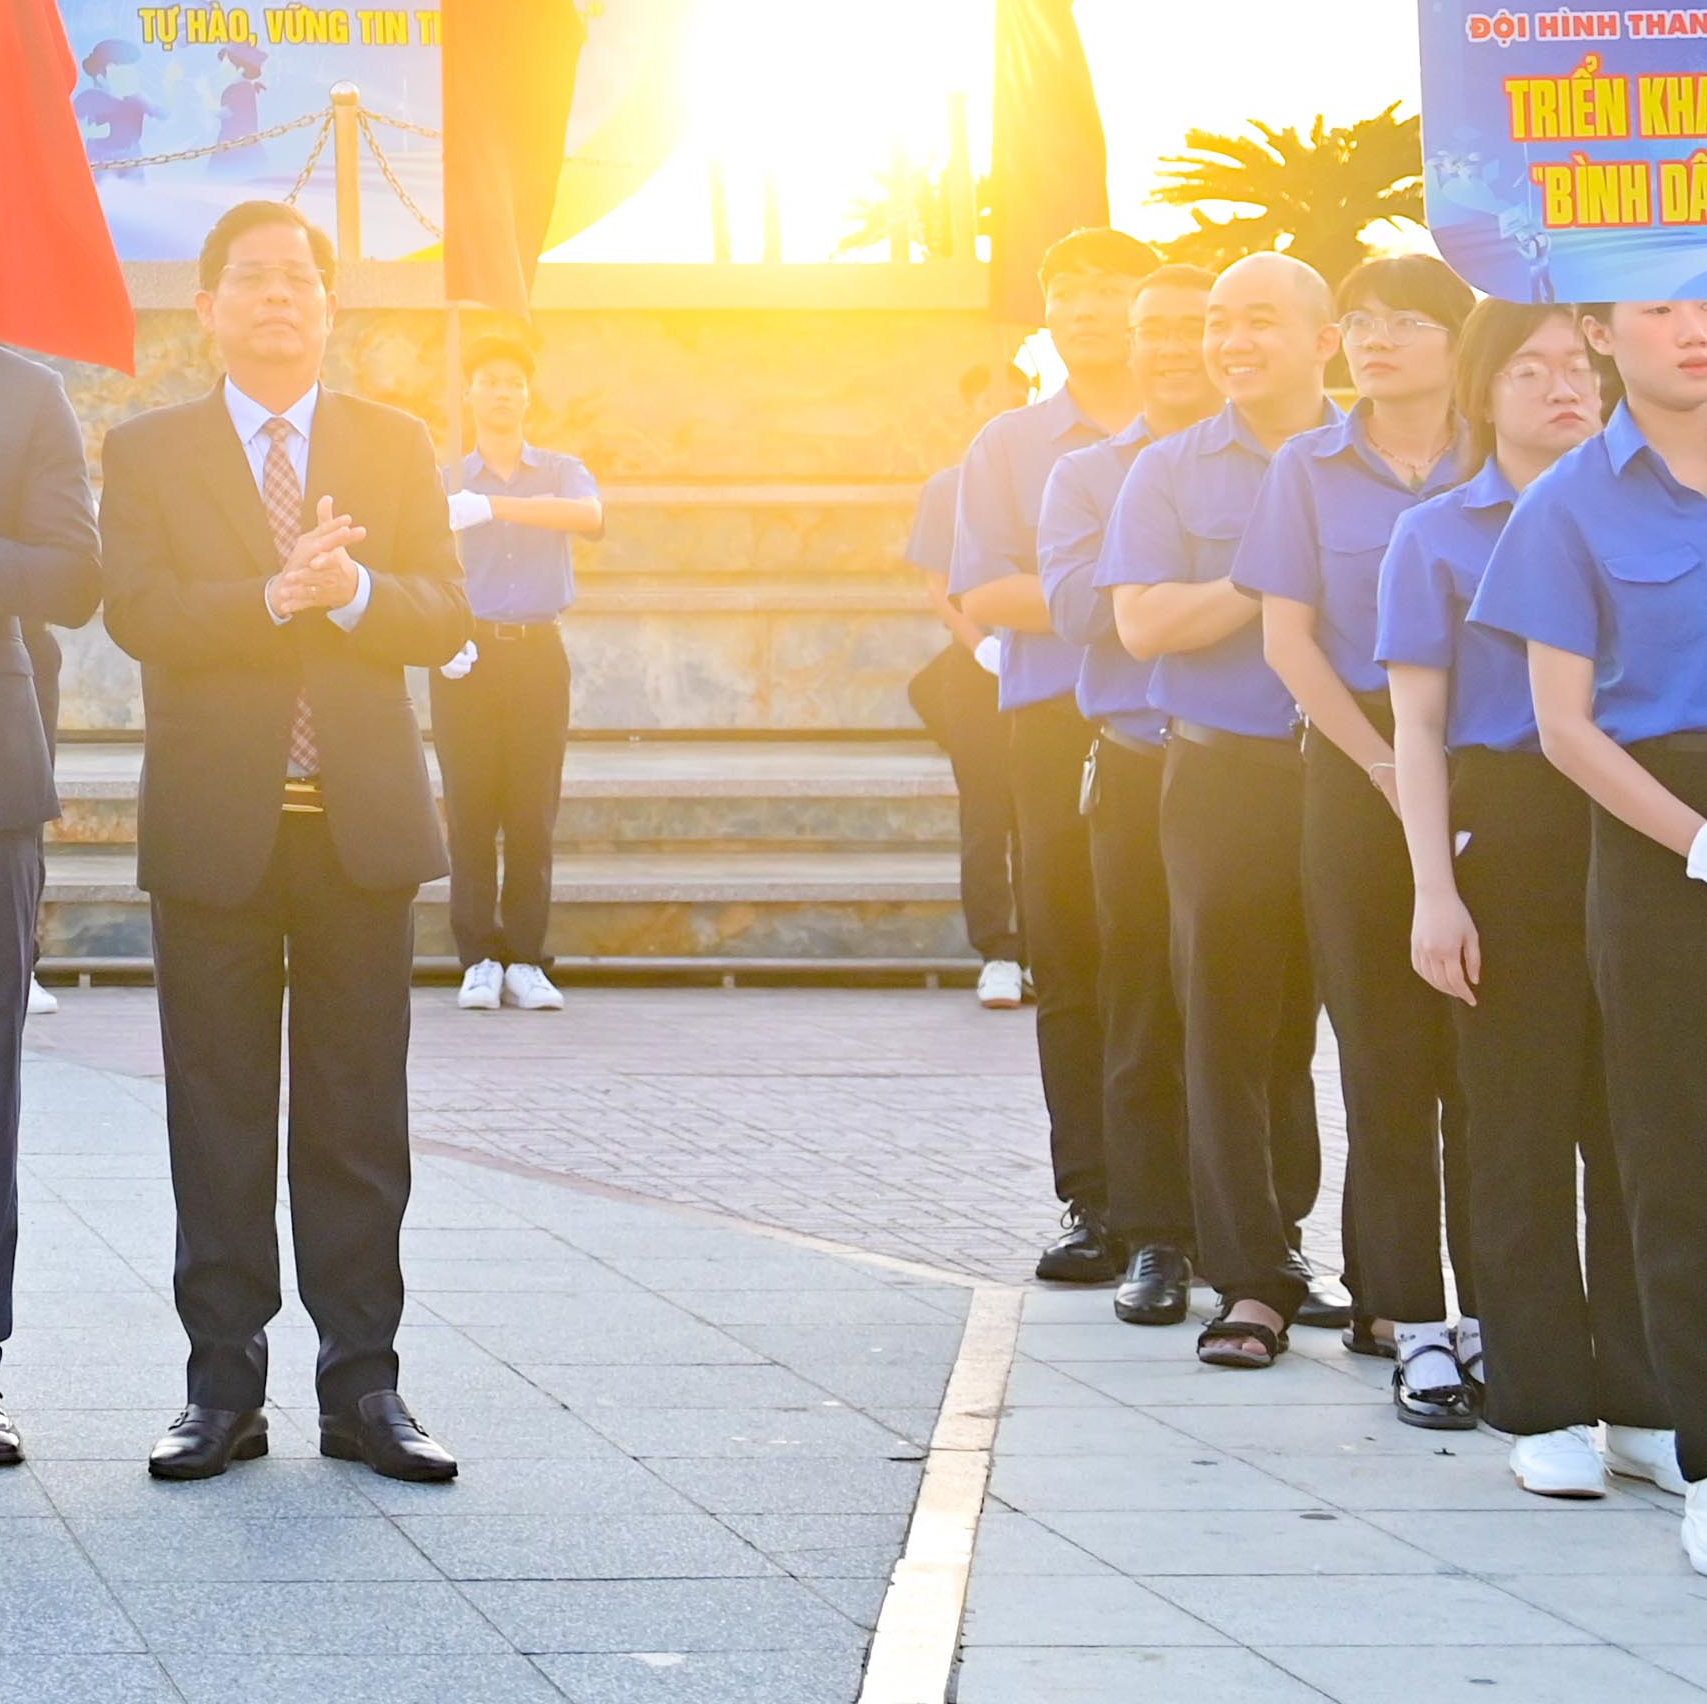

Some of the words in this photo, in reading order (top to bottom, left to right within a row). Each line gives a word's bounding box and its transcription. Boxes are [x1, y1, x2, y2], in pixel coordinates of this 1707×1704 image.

[137, 4, 182, 52] TỰ
[185, 1, 258, 47] HÀO,
[263, 2, 350, 46] VỮNG
[356, 9, 410, 46] TIN
[1469, 10, 1528, 46] ĐỘI
[1537, 7, 1620, 39] HÌNH
[1504, 54, 1629, 139] TRIỂN
